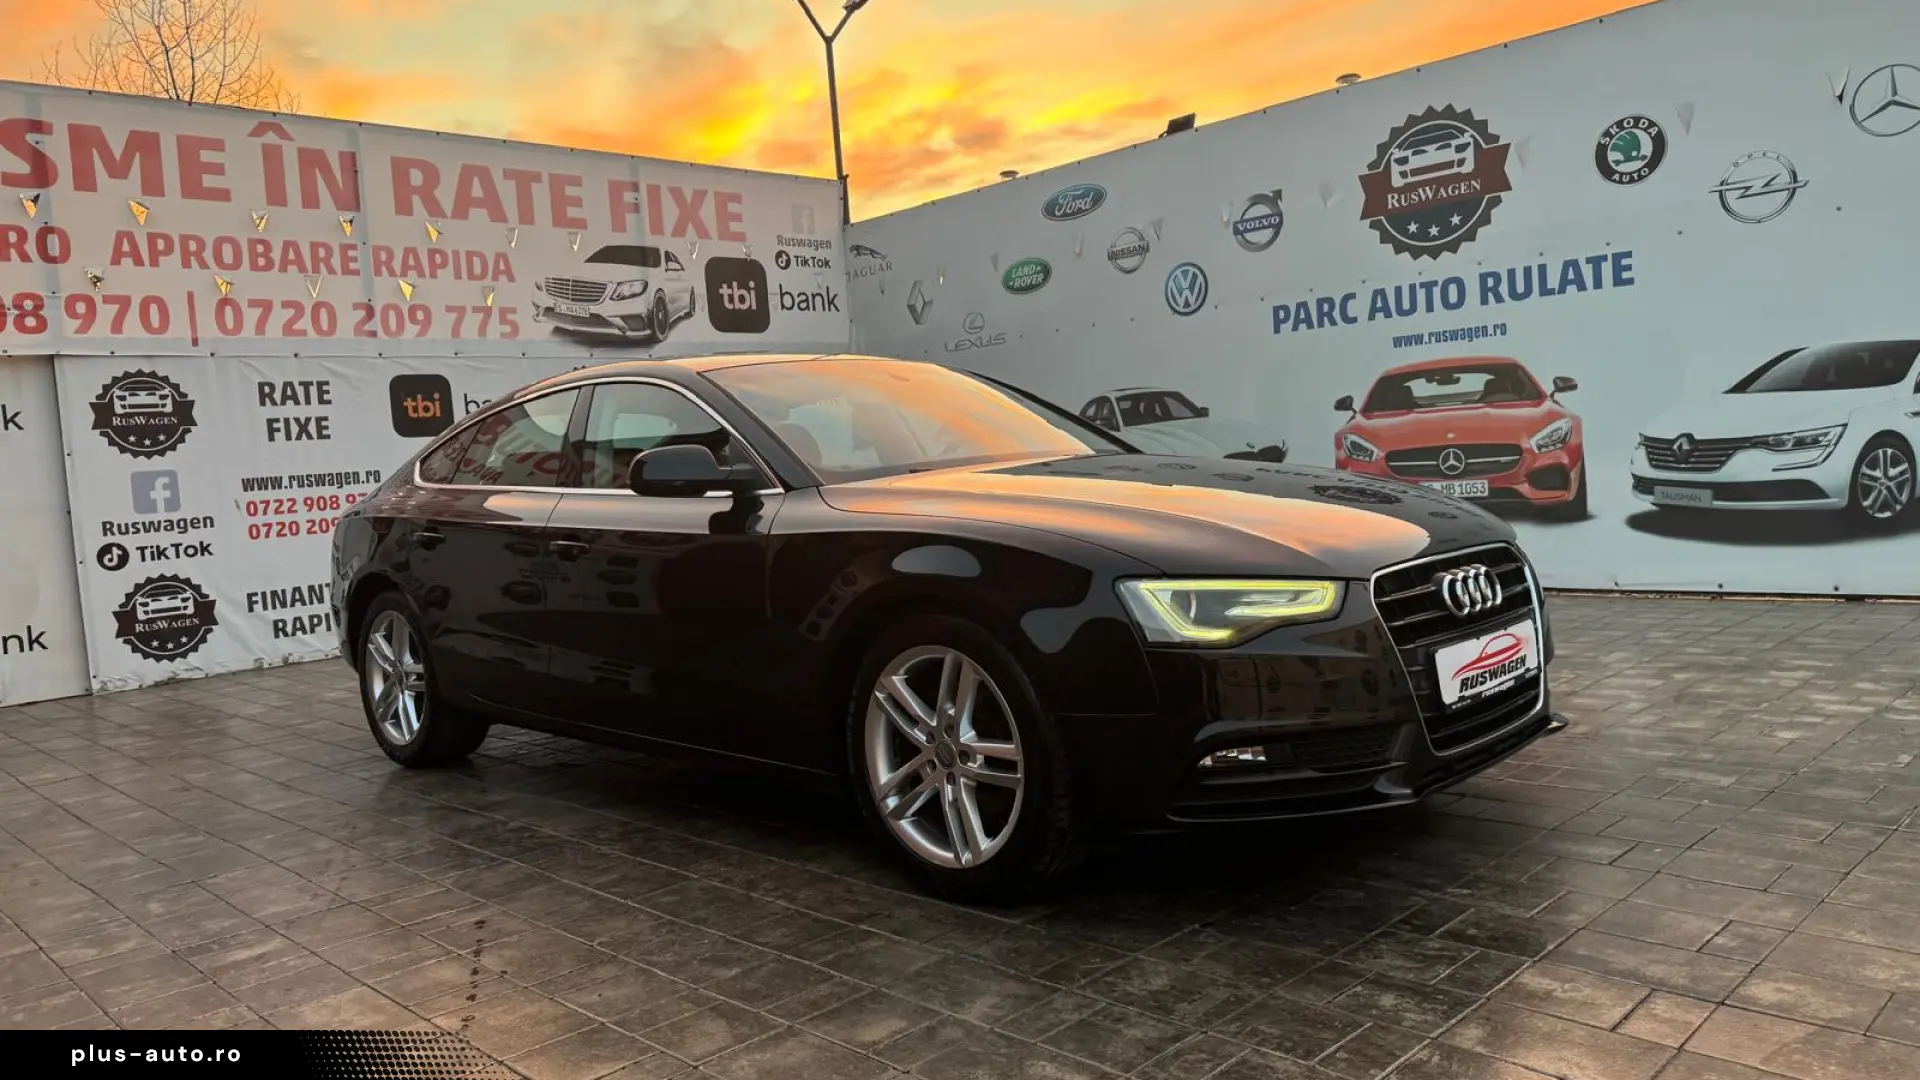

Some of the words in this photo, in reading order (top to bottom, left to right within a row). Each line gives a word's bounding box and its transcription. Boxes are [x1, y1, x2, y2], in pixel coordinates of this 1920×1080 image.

[0, 116, 231, 203] SME
[247, 121, 361, 213] ÎN
[389, 156, 588, 231] RATE
[607, 178, 747, 243] FIXE
[1612, 167, 1651, 183] AUTO
[1055, 188, 1097, 217] Ford
[1236, 214, 1281, 232] VOLVO
[0, 223, 72, 265] RO
[109, 229, 361, 277] APROBARE
[372, 244, 516, 283] RAPIDA
[776, 234, 832, 252] Ruswagen
[1109, 243, 1147, 259] NISSAN
[793, 254, 831, 270] TikTok
[1011, 264, 1036, 279] LAND
[1014, 273, 1045, 288] ROVER
[718, 280, 757, 310] tbi
[778, 284, 840, 313] bank
[1272, 291, 1359, 335] PARC
[1367, 275, 1467, 322] AUTO
[1479, 250, 1636, 307] RULATE
[64, 293, 171, 336] 970
[214, 297, 338, 338] 0720
[353, 302, 432, 339] 209
[444, 303, 520, 340] 775
[944, 331, 1008, 354] LEXUS
[1392, 321, 1508, 349] www.ruswagen.ro
[257, 380, 332, 407] RATE
[403, 392, 442, 419] tbi
[266, 416, 331, 442] FIXE
[241, 469, 381, 492] www.ruswagen.ro
[1457, 481, 1487, 496] 1053
[245, 497, 299, 518] 0722
[303, 495, 342, 513] 908
[101, 514, 215, 537] Ruswagen
[248, 520, 301, 541] 0720
[136, 540, 214, 563] TikTok
[1458, 654, 1528, 694] RUSWAGEN
